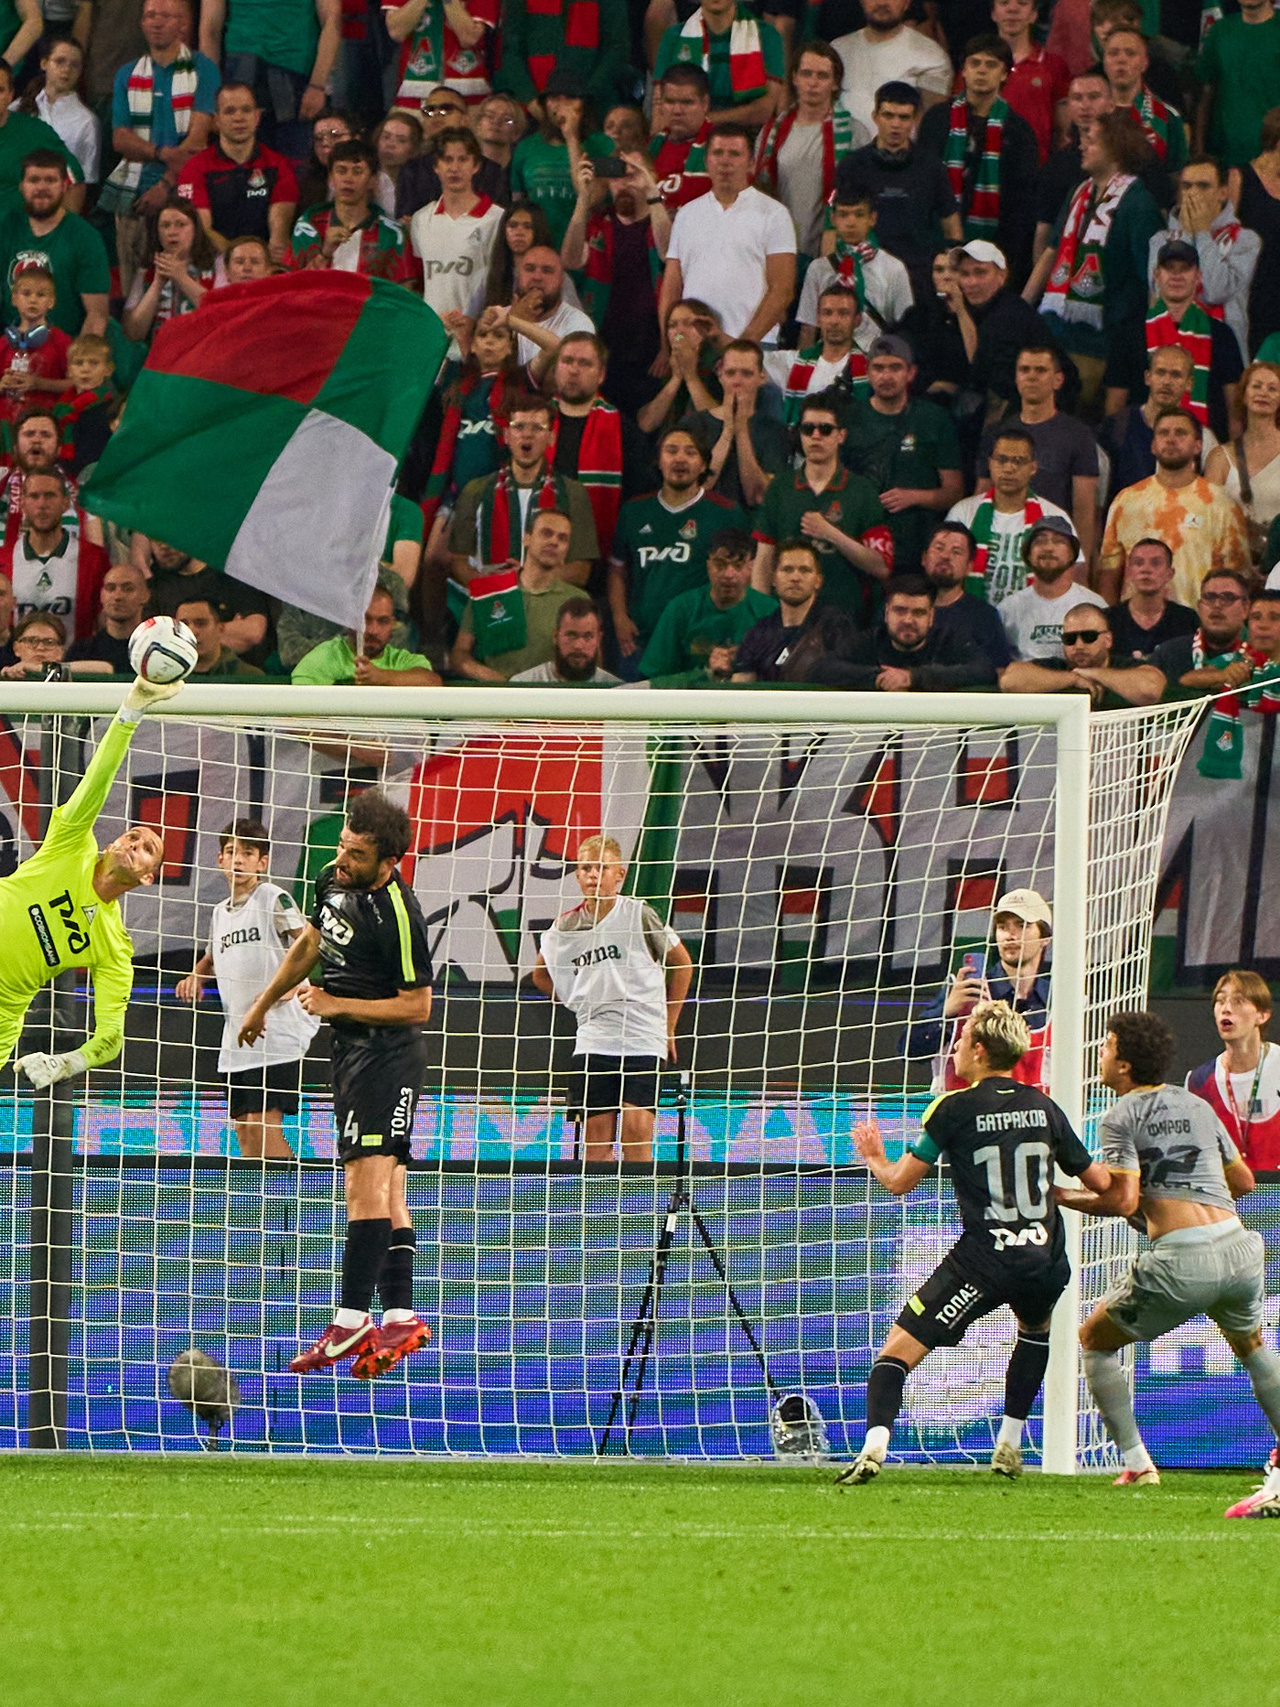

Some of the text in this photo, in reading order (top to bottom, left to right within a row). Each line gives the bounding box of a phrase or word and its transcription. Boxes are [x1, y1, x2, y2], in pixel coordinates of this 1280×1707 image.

[390, 1086, 413, 1138] ТОПАЗ
[975, 1109, 1048, 1132] БАТРАКОВ
[973, 1141, 1051, 1223] 10
[935, 1283, 978, 1325] ТОПАЗ
